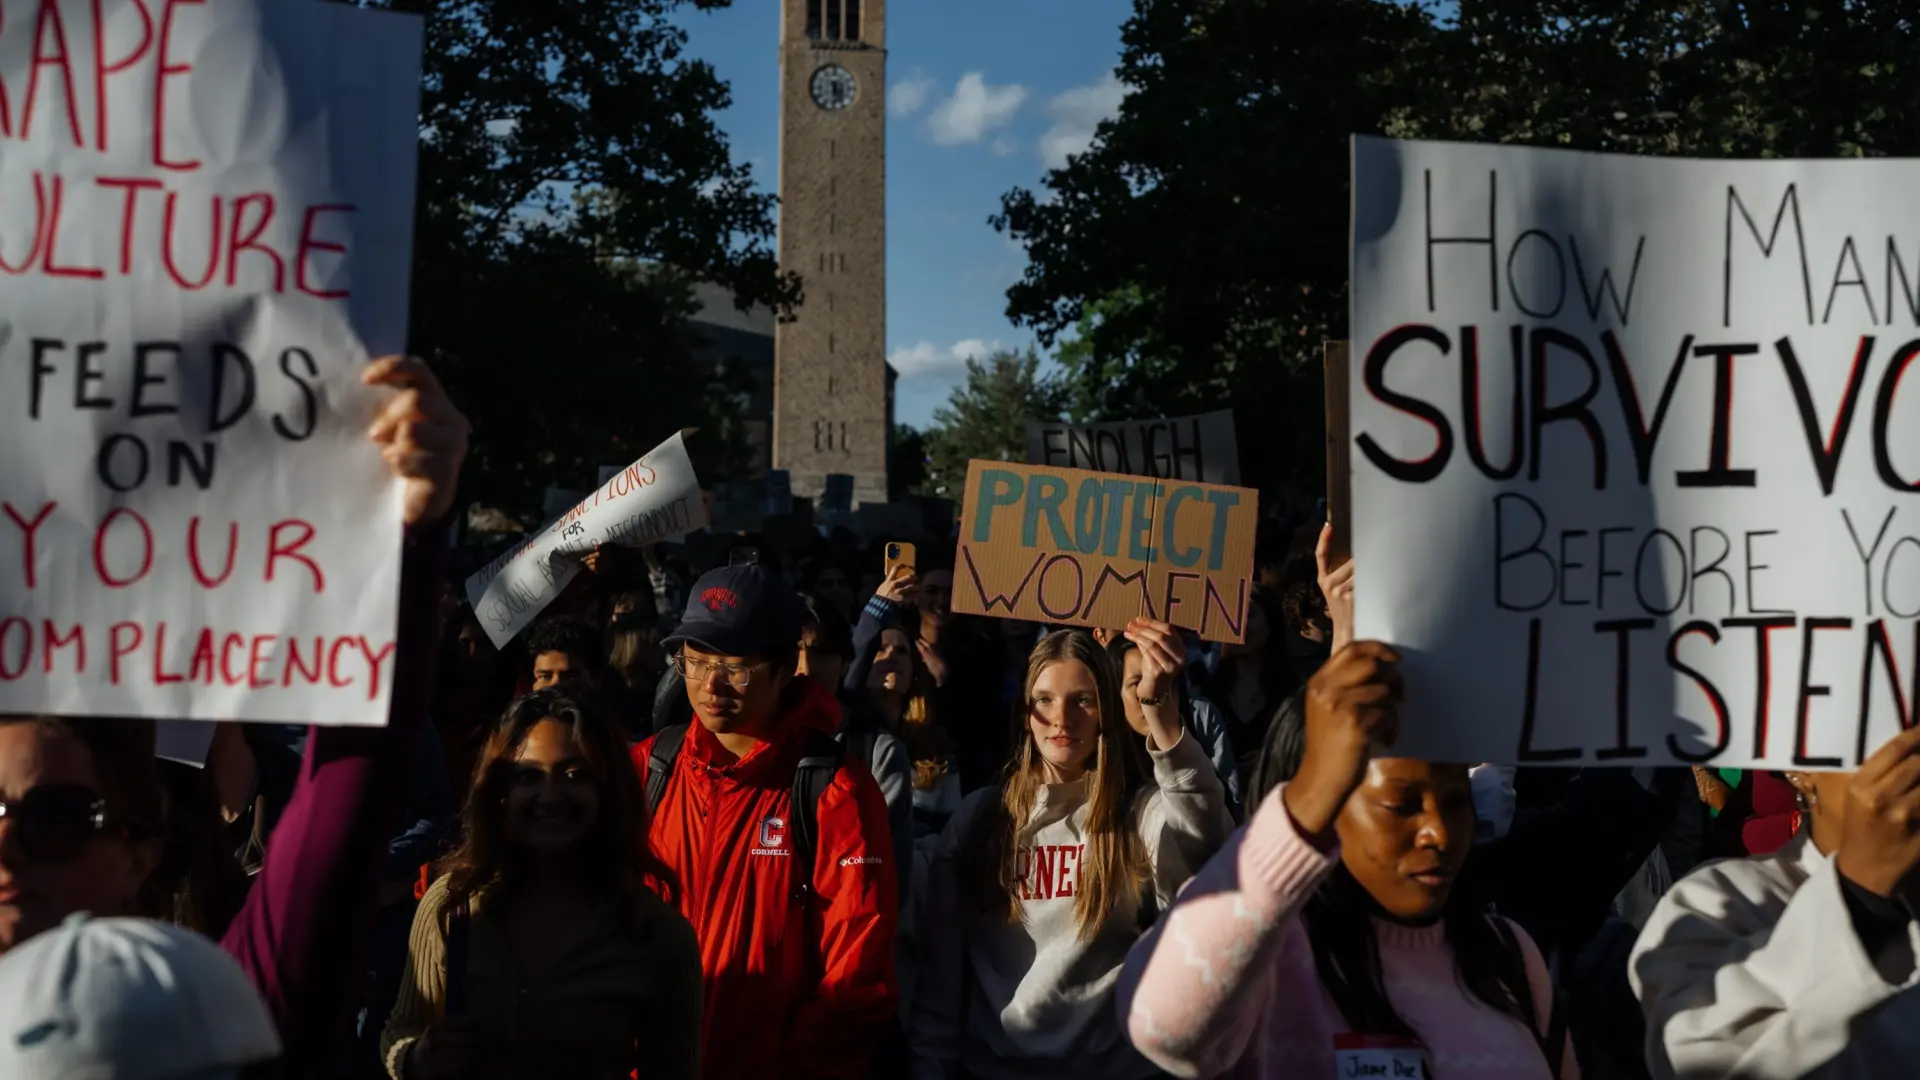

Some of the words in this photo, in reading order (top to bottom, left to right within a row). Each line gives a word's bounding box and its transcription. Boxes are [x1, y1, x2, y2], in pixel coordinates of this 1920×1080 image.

[0, 0, 208, 172] APE
[0, 170, 358, 298] ULTURE
[1424, 168, 1646, 326] HOW
[1723, 182, 1920, 327] MAN
[29, 338, 319, 442] FEEDS
[1354, 322, 1920, 497] SURVIVO
[97, 433, 216, 492] ON
[1043, 420, 1202, 481] ENOUGH
[2, 498, 325, 593] YOUR
[486, 578, 542, 632] SEXUAL
[605, 496, 691, 547] MISCONDUCT
[562, 521, 585, 541] FOR
[973, 469, 1240, 571] PROTECT
[1491, 492, 1797, 617] BEFORE
[1841, 505, 1920, 619] YO
[962, 545, 1246, 637] WOMEN
[0, 615, 396, 700] OMPLACENCY
[1516, 616, 1920, 768] LISTEN
[751, 848, 790, 856] CORNELL
[847, 856, 883, 865] Columbia
[1015, 843, 1085, 900] RNE
